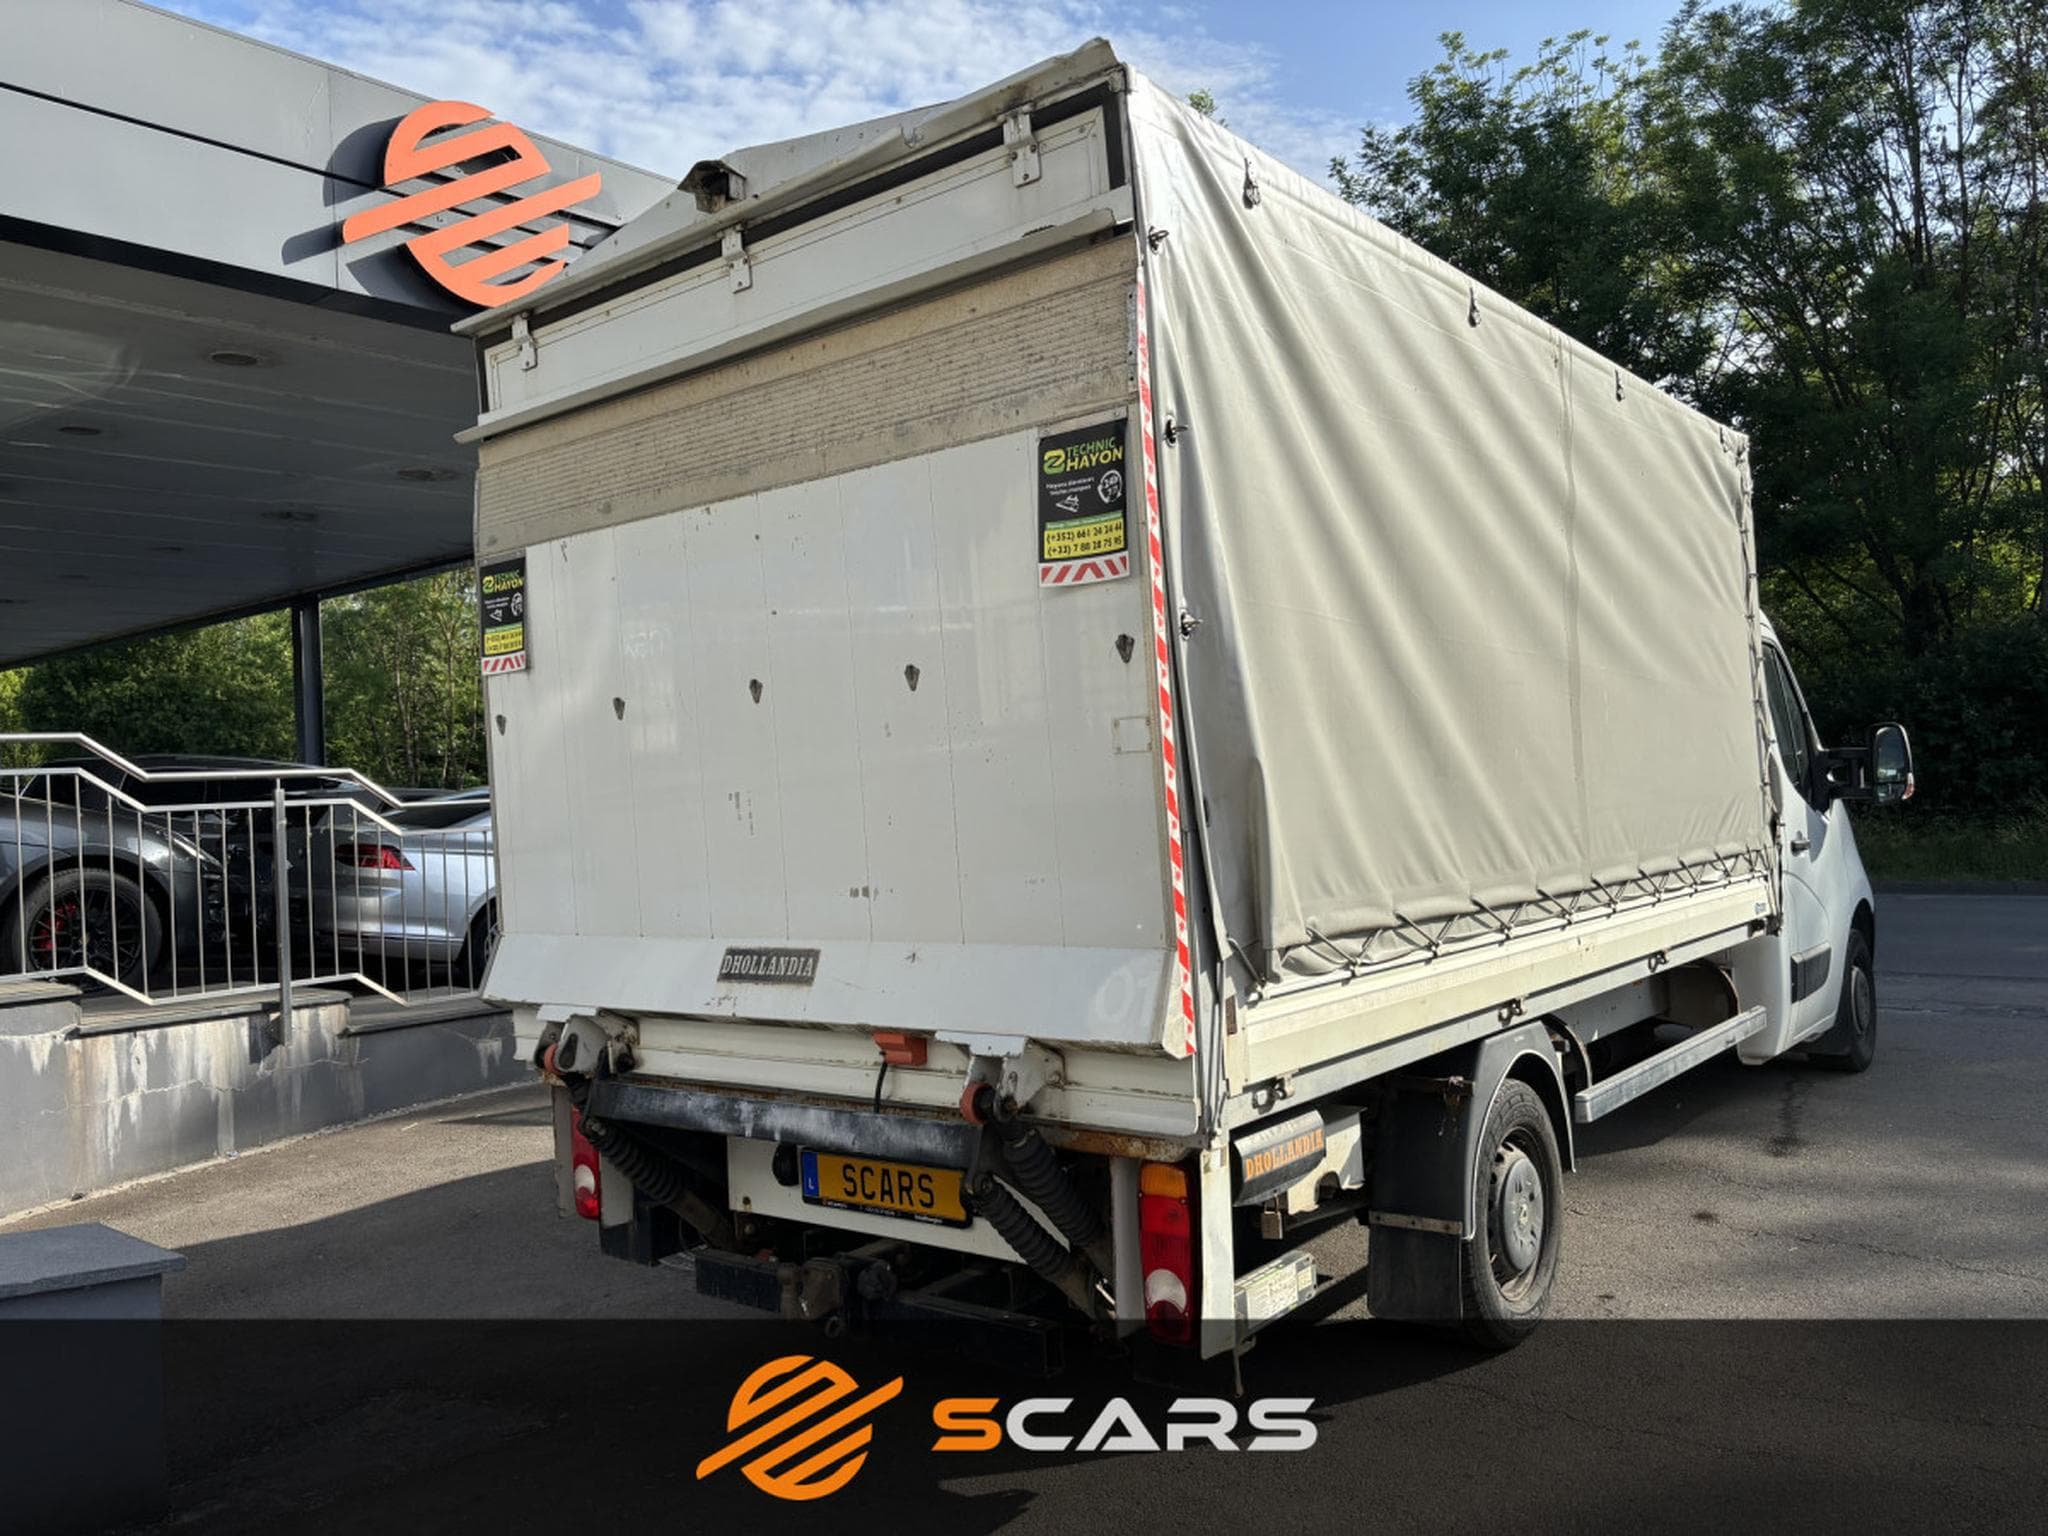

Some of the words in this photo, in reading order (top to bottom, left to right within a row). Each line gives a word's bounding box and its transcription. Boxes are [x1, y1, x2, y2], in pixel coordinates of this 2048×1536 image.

[1066, 437, 1116, 457] TECHNIC
[1066, 446, 1123, 471] HAYON
[721, 954, 814, 976] DHOLLANDIA
[1245, 1129, 1323, 1179] DHOLLANDIA
[808, 1177, 815, 1190] L
[841, 1162, 935, 1208] SCARS
